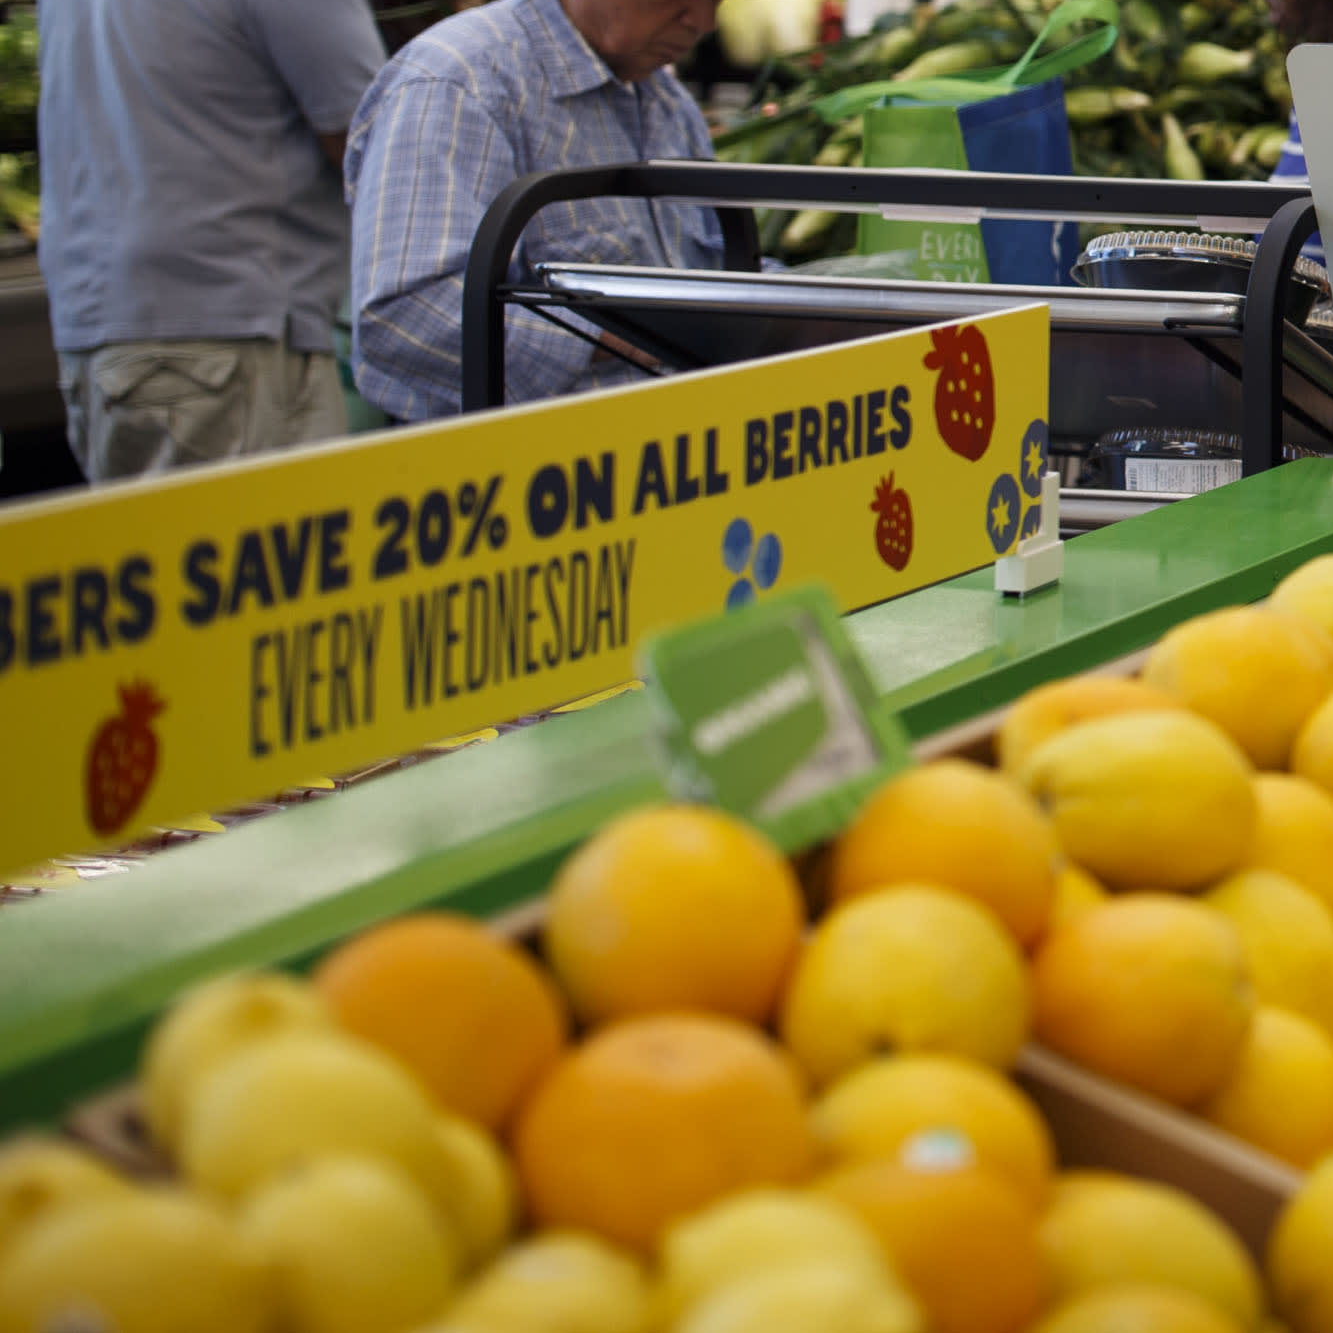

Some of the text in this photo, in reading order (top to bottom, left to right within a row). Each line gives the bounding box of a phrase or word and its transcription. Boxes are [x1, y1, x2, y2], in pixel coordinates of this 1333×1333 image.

[180, 508, 354, 628] SAVE
[371, 475, 507, 580] 20%
[526, 451, 618, 539] ON
[632, 430, 730, 516] ALL
[744, 384, 912, 471] BERRIES
[247, 537, 637, 760] EVERY WEDNESDAY
